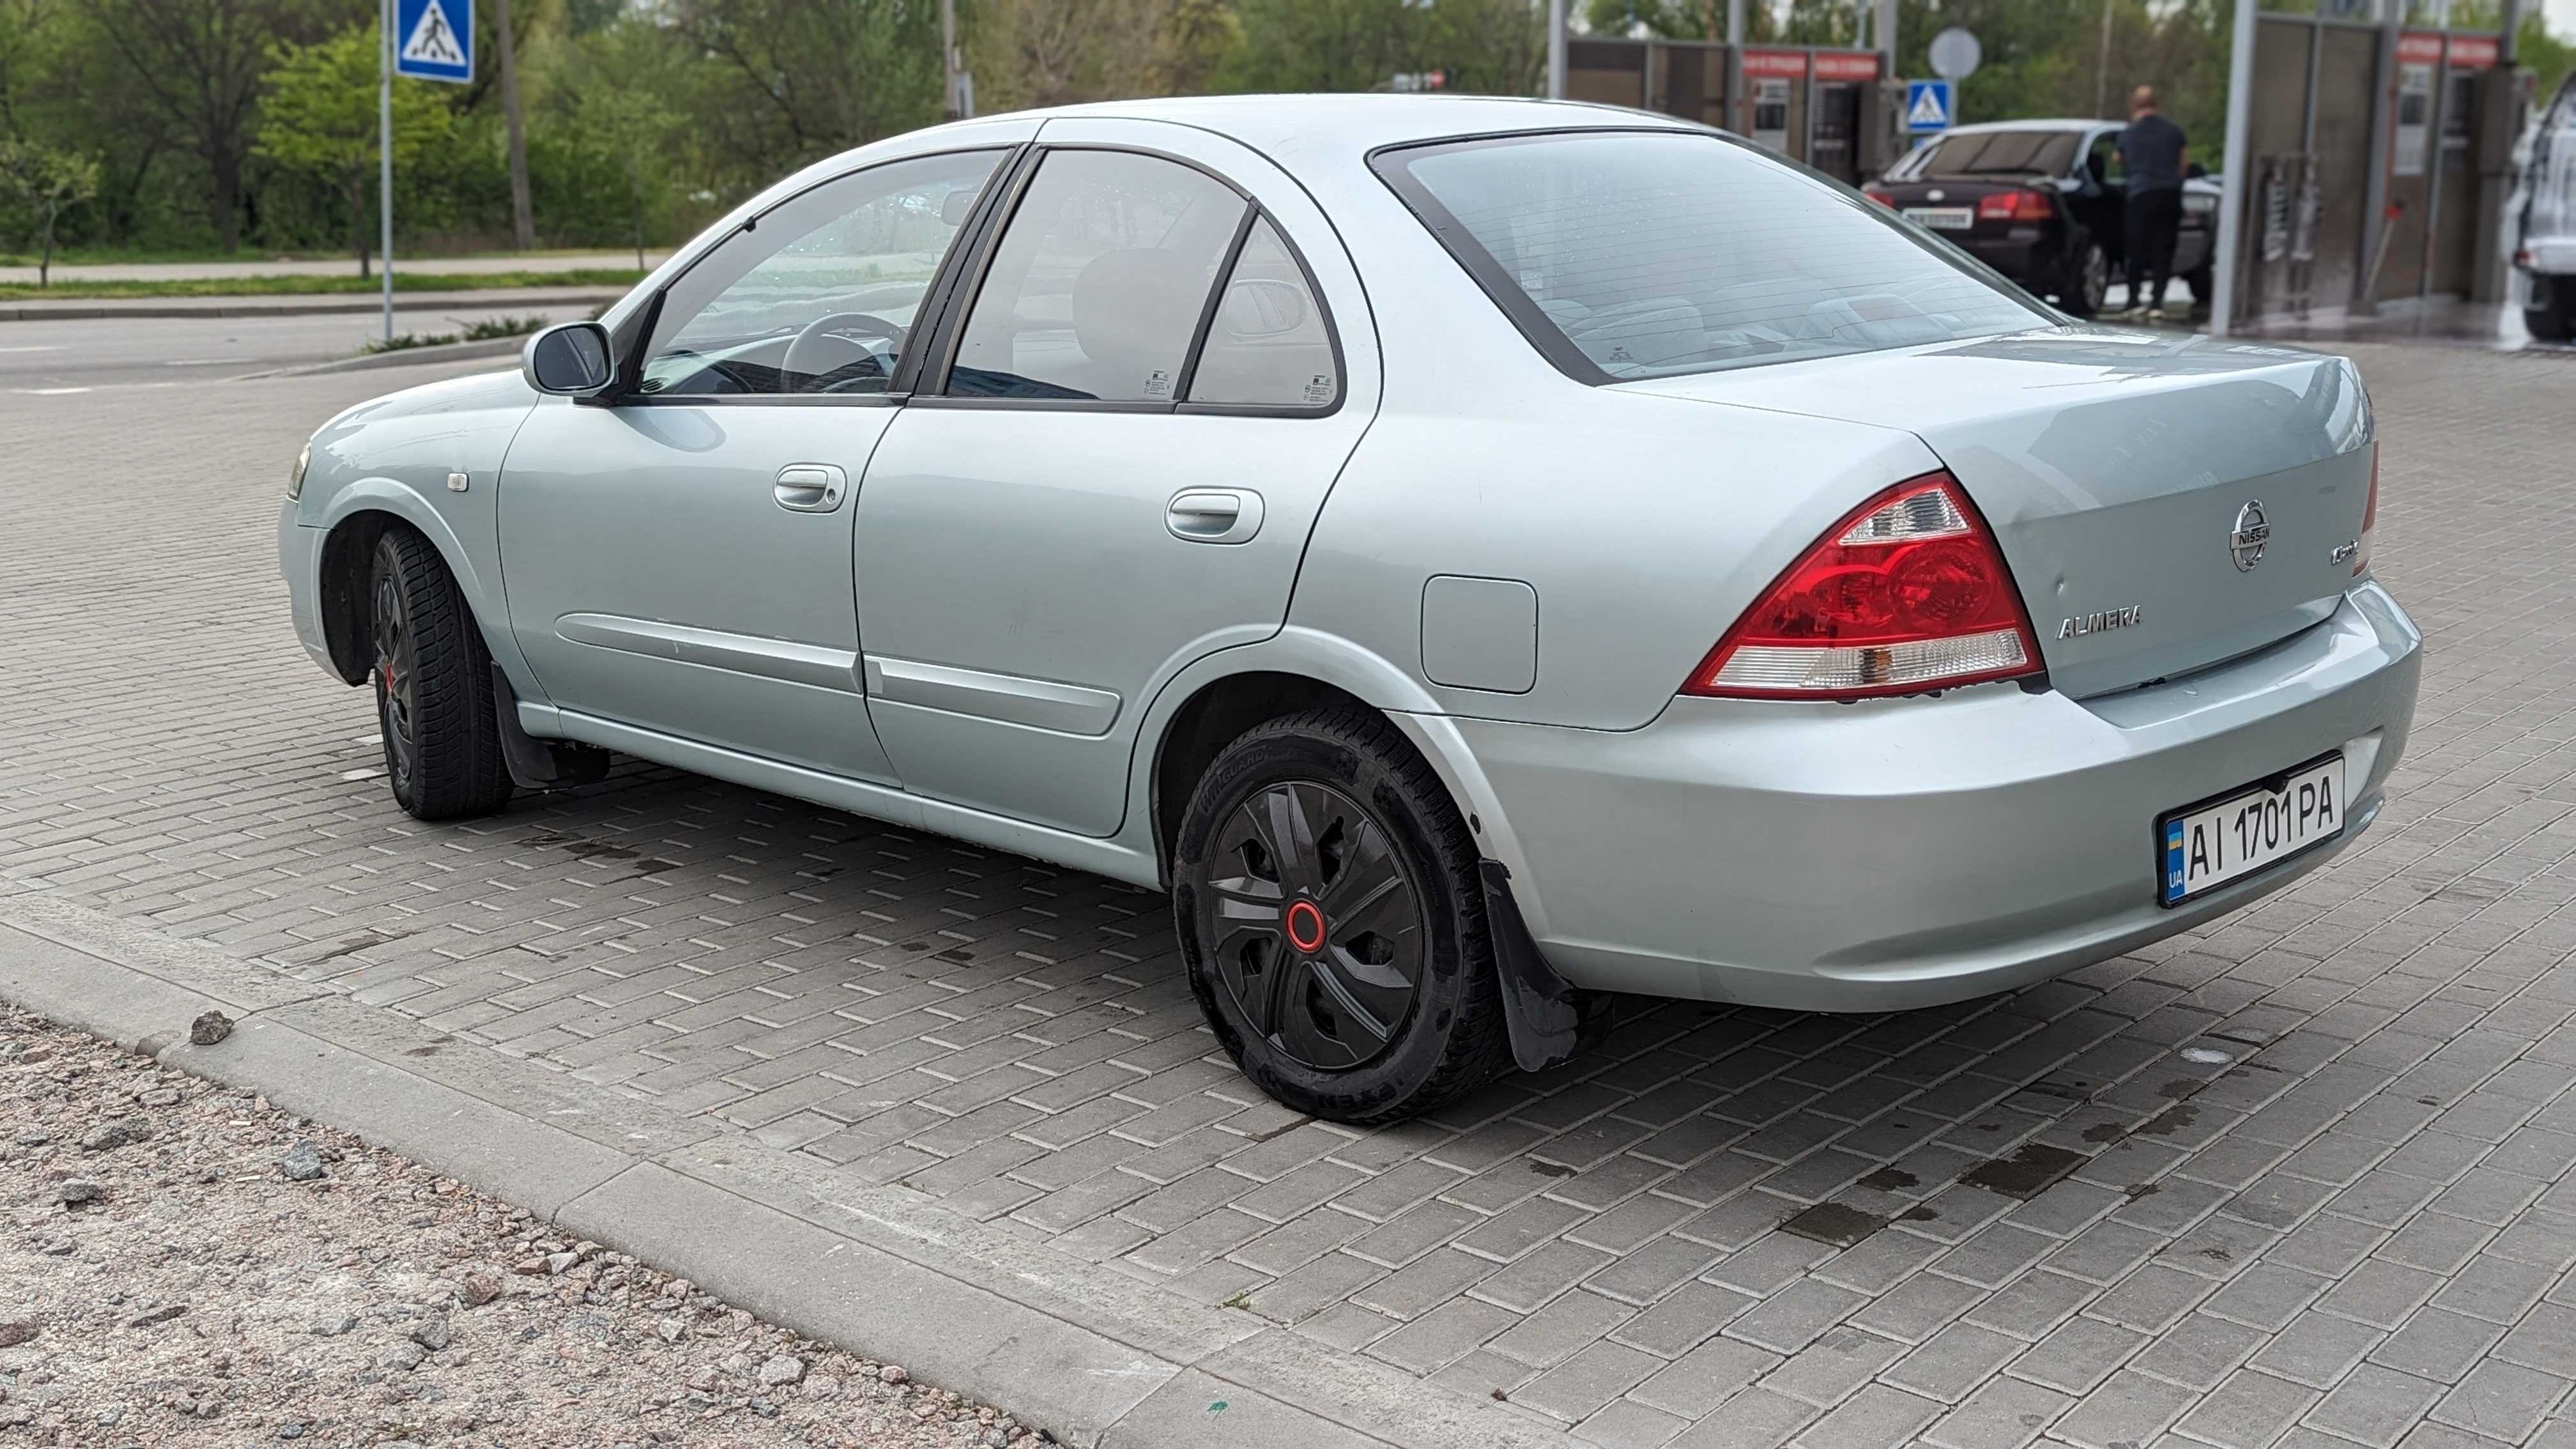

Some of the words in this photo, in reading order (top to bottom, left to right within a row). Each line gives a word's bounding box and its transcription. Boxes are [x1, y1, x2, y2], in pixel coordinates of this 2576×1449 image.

[2238, 526, 2269, 545] NISSAN
[2055, 604, 2143, 640] ALMERA
[2188, 816, 2222, 881] AI
[2234, 791, 2292, 862] 1701
[2299, 776, 2333, 837] PA
[2169, 871, 2183, 889] UA
